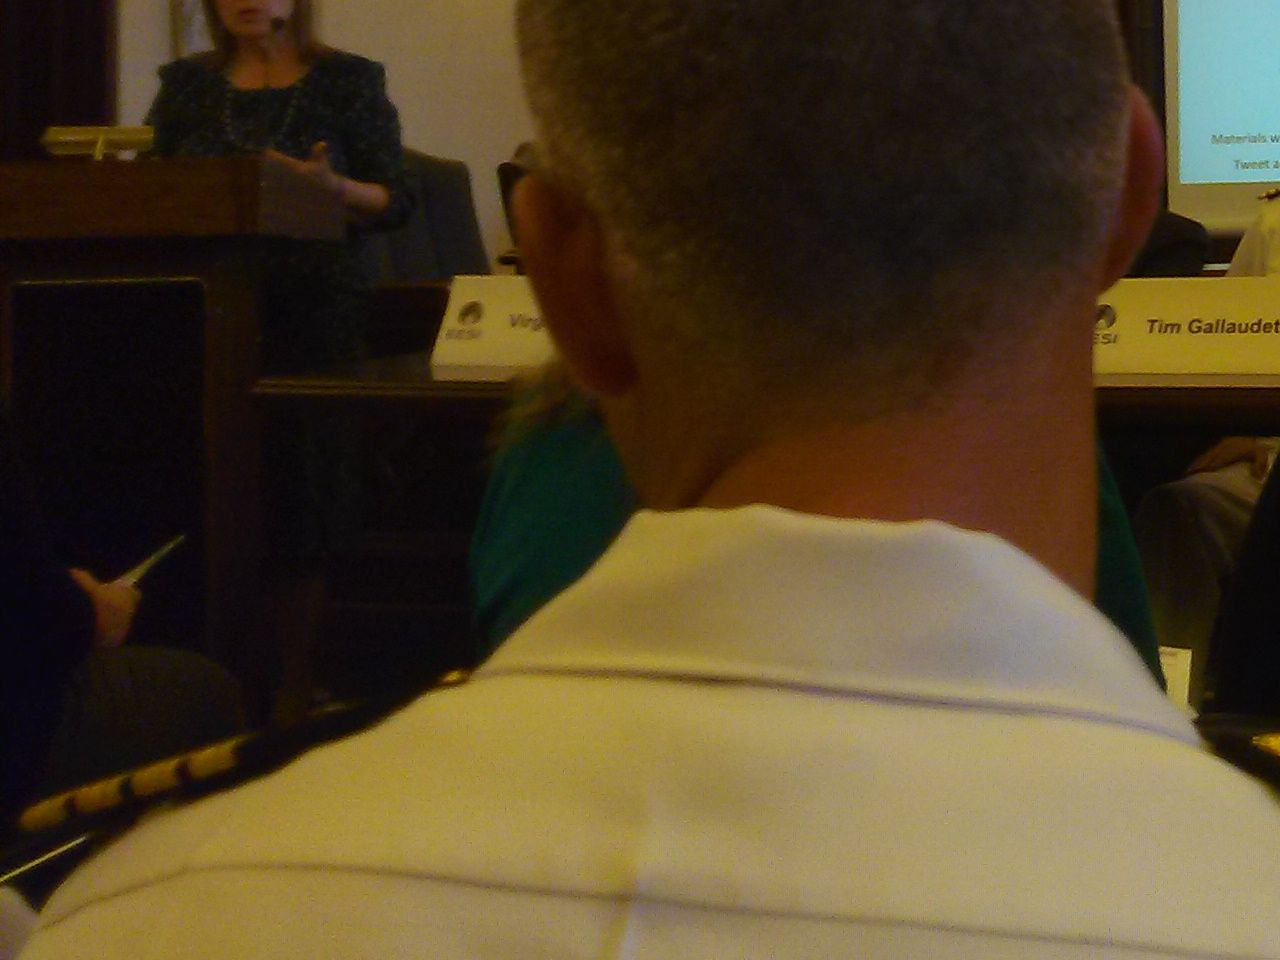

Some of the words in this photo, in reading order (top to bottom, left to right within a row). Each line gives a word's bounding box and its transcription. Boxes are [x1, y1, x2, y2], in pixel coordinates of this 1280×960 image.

[1210, 133, 1267, 144] Materials
[1234, 159, 1270, 169] Tweet
[1147, 319, 1181, 334] Tim
